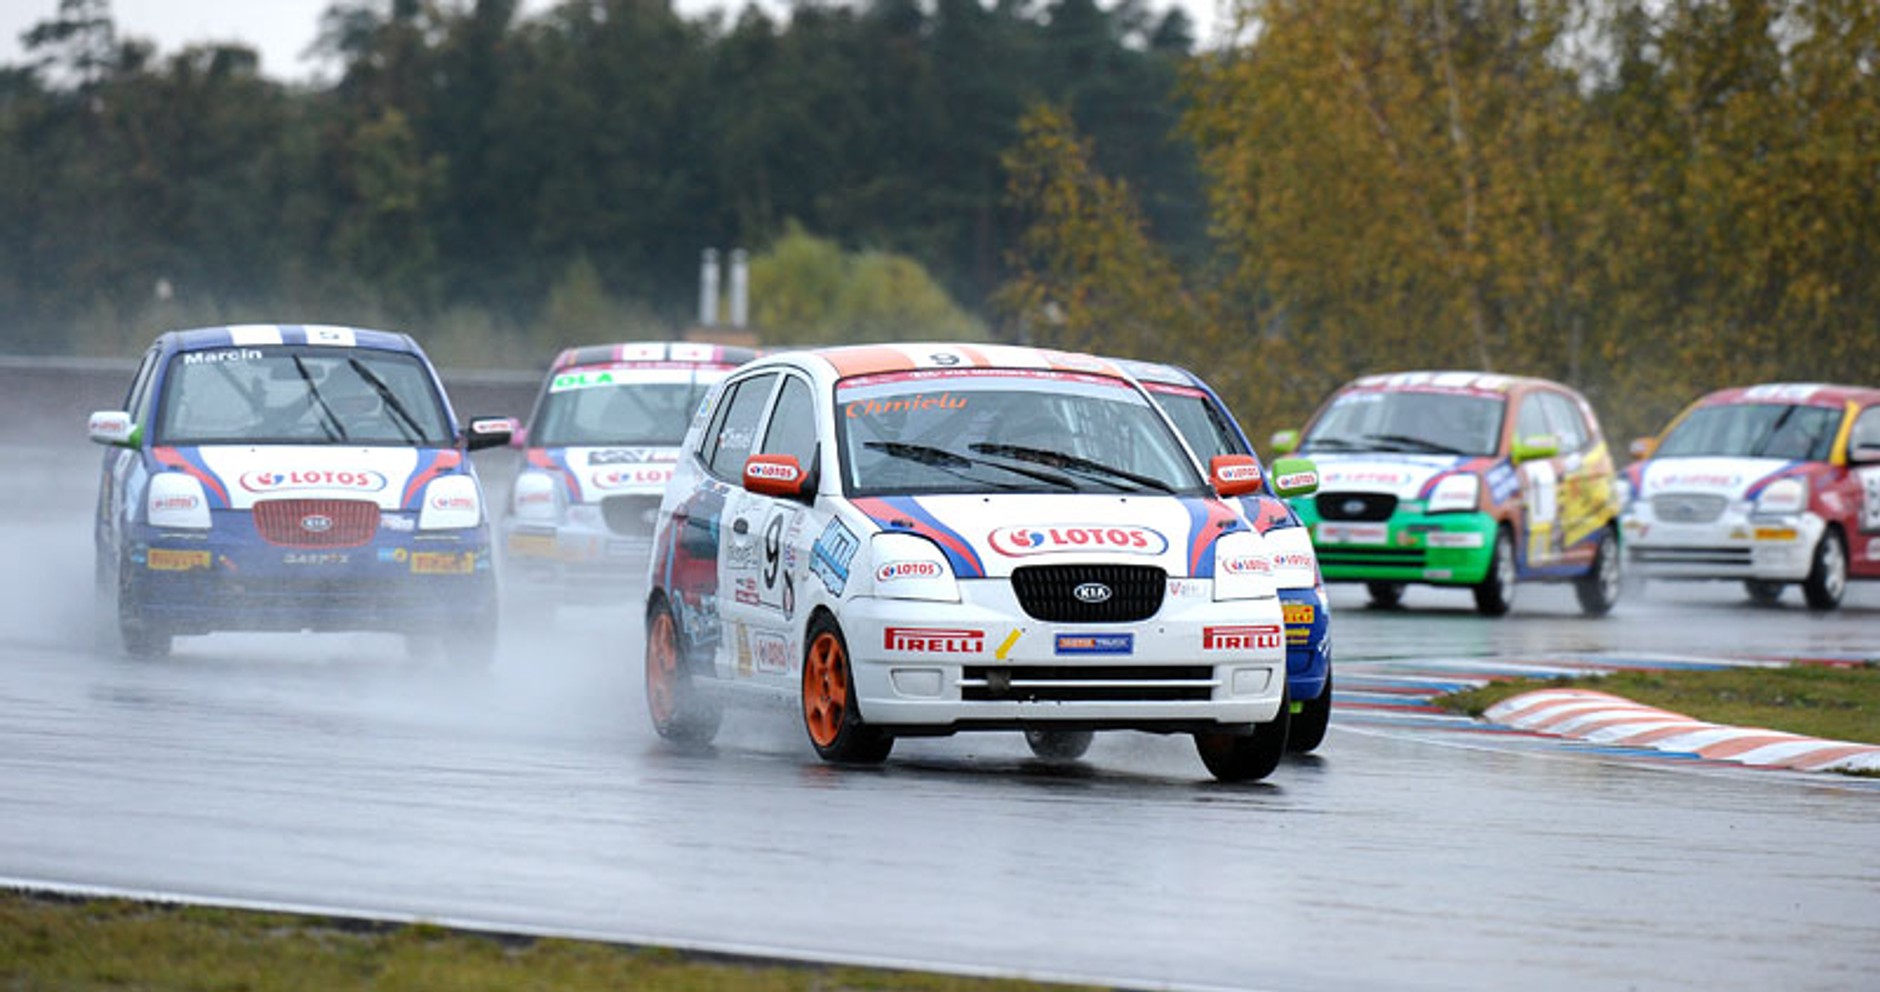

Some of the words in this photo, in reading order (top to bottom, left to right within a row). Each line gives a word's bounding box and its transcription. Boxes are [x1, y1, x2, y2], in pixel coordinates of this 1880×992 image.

[184, 349, 262, 365] Marcin
[930, 353, 960, 366] 9
[555, 373, 614, 388] OLA
[846, 392, 967, 418] Chmielu
[290, 471, 369, 486] LOTOS
[762, 465, 793, 478] LOTOS
[1049, 528, 1148, 548] LOTOS
[763, 513, 784, 590] 9
[896, 563, 935, 576] LOTOS
[1079, 587, 1107, 596] KIA
[884, 627, 985, 652] PIRELLI
[1203, 625, 1280, 650] PIRELLI
